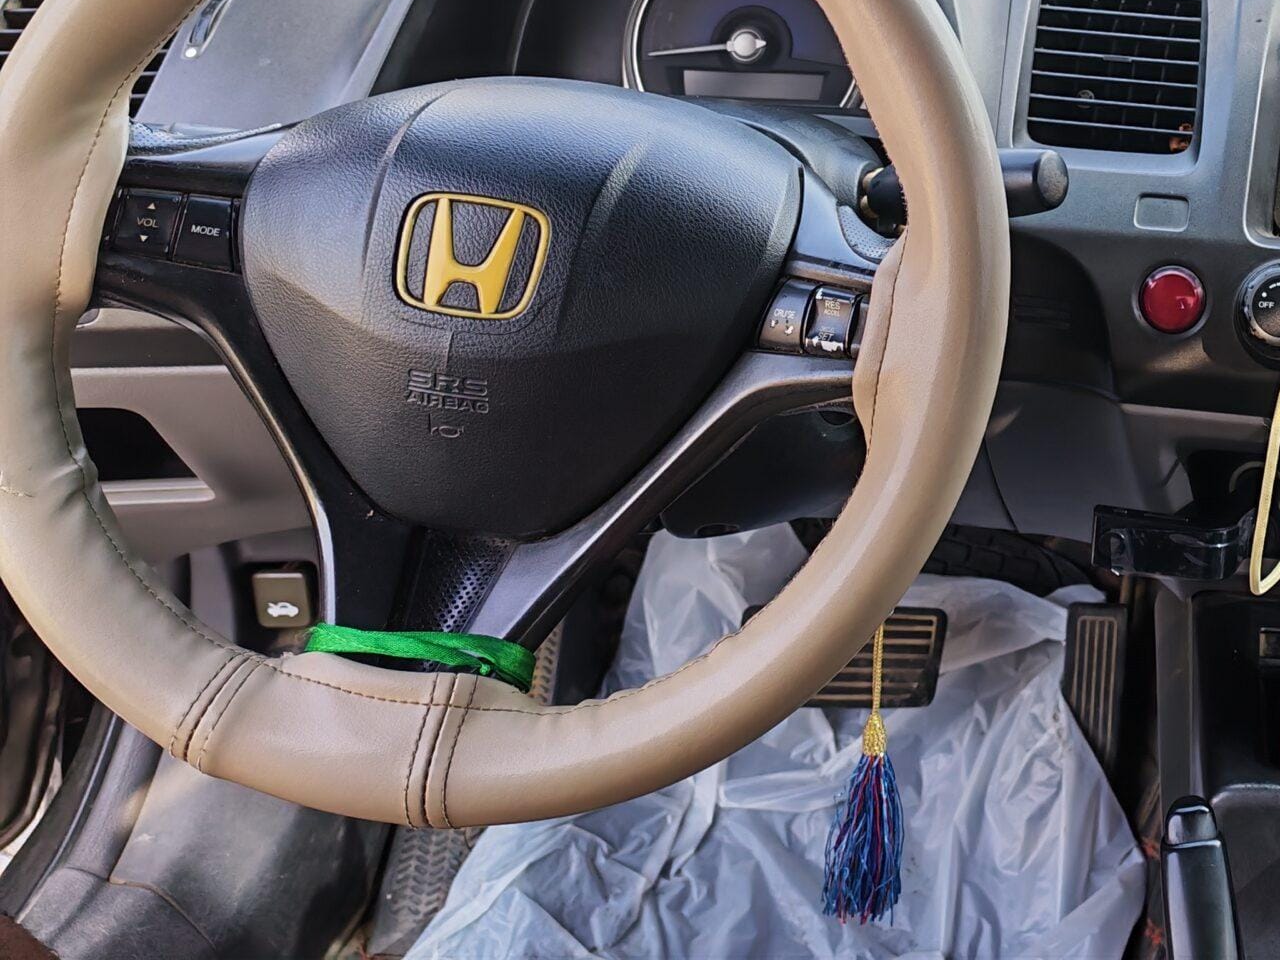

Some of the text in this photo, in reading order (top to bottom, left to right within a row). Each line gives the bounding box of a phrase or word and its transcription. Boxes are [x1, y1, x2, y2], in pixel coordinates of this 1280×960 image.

[136, 216, 159, 229] VOL
[190, 224, 221, 237] MODE
[824, 300, 841, 310] RES
[1258, 301, 1275, 309] OFF
[817, 331, 835, 342] SET
[407, 369, 488, 396] SRS
[407, 393, 489, 414] AIRBAG
